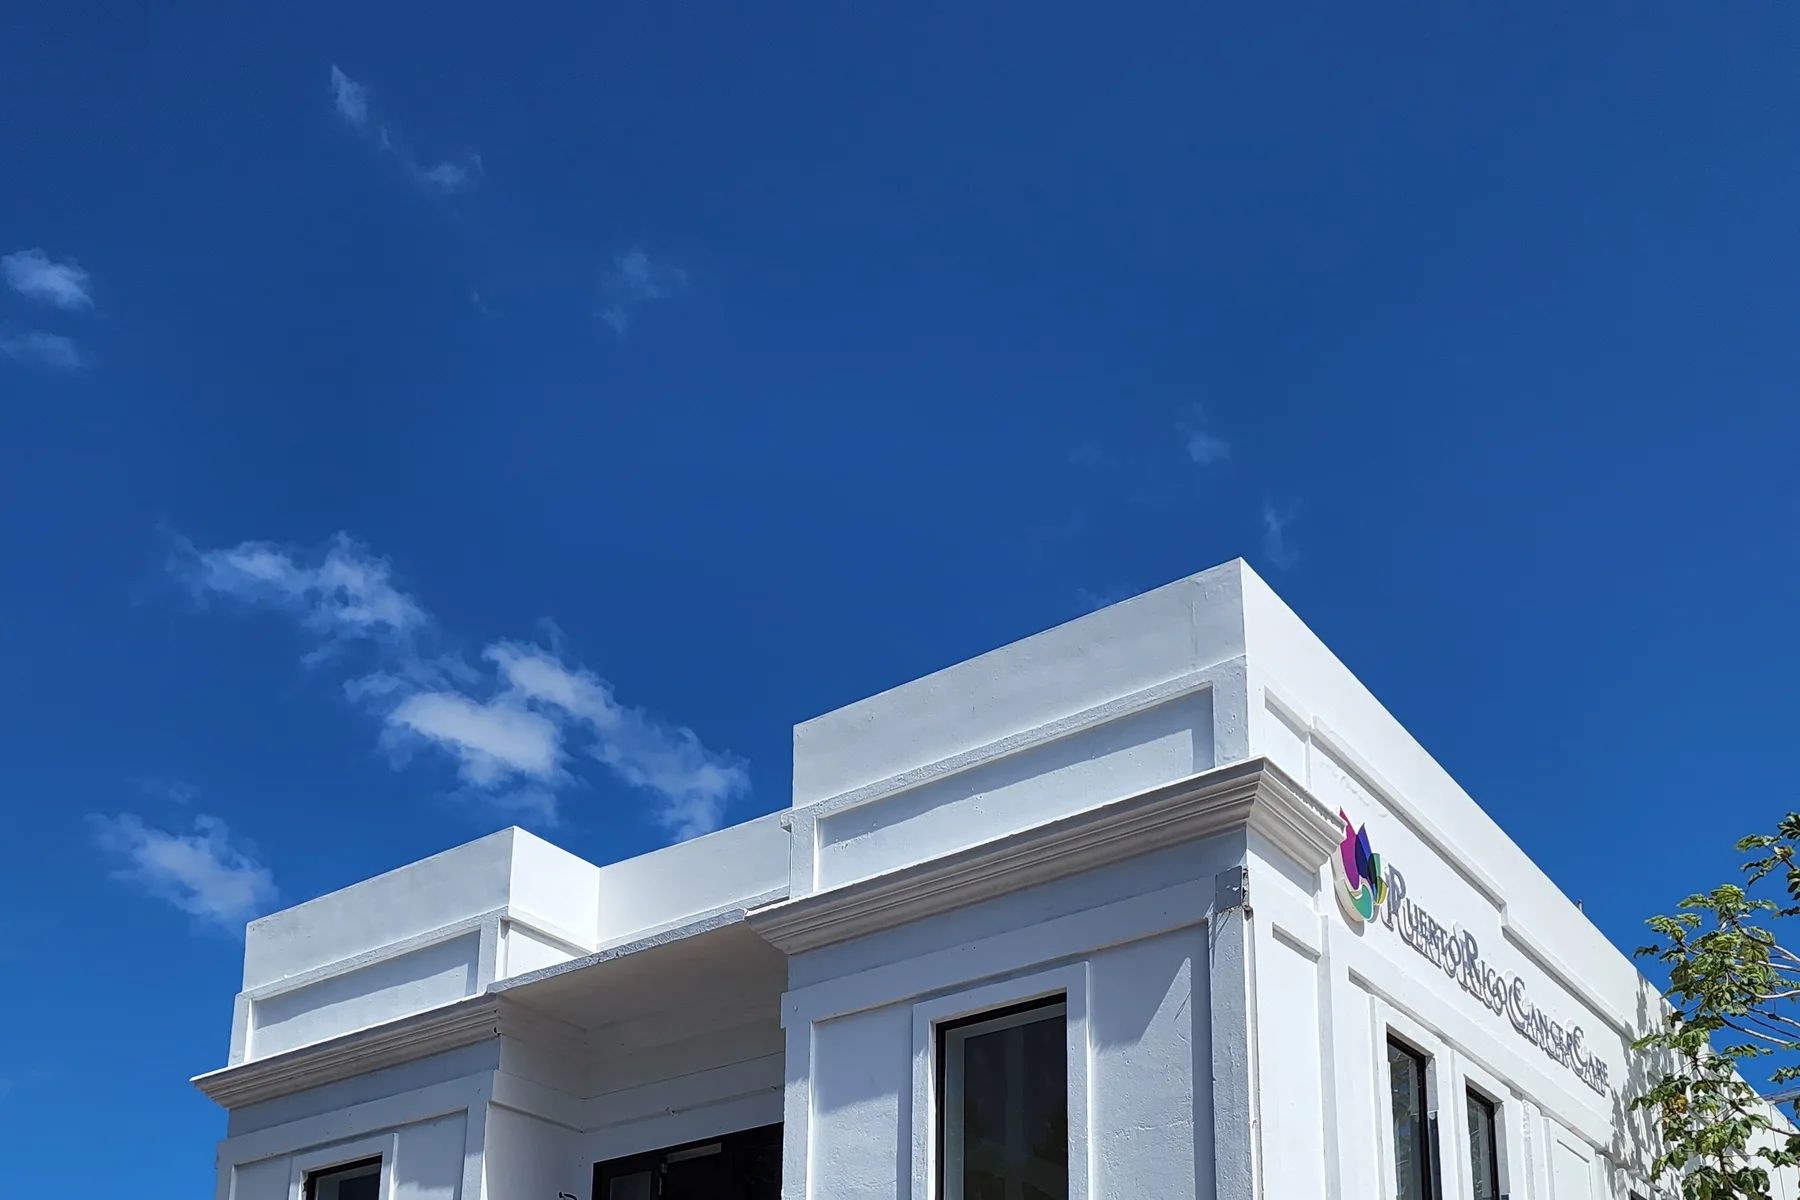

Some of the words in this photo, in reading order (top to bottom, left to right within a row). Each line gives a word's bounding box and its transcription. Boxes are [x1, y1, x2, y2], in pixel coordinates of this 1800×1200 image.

[1383, 862, 1462, 970] PUERTO
[1459, 929, 1508, 1011] RICO
[1509, 976, 1572, 1063] CANCER
[1571, 1025, 1608, 1090] CARE
